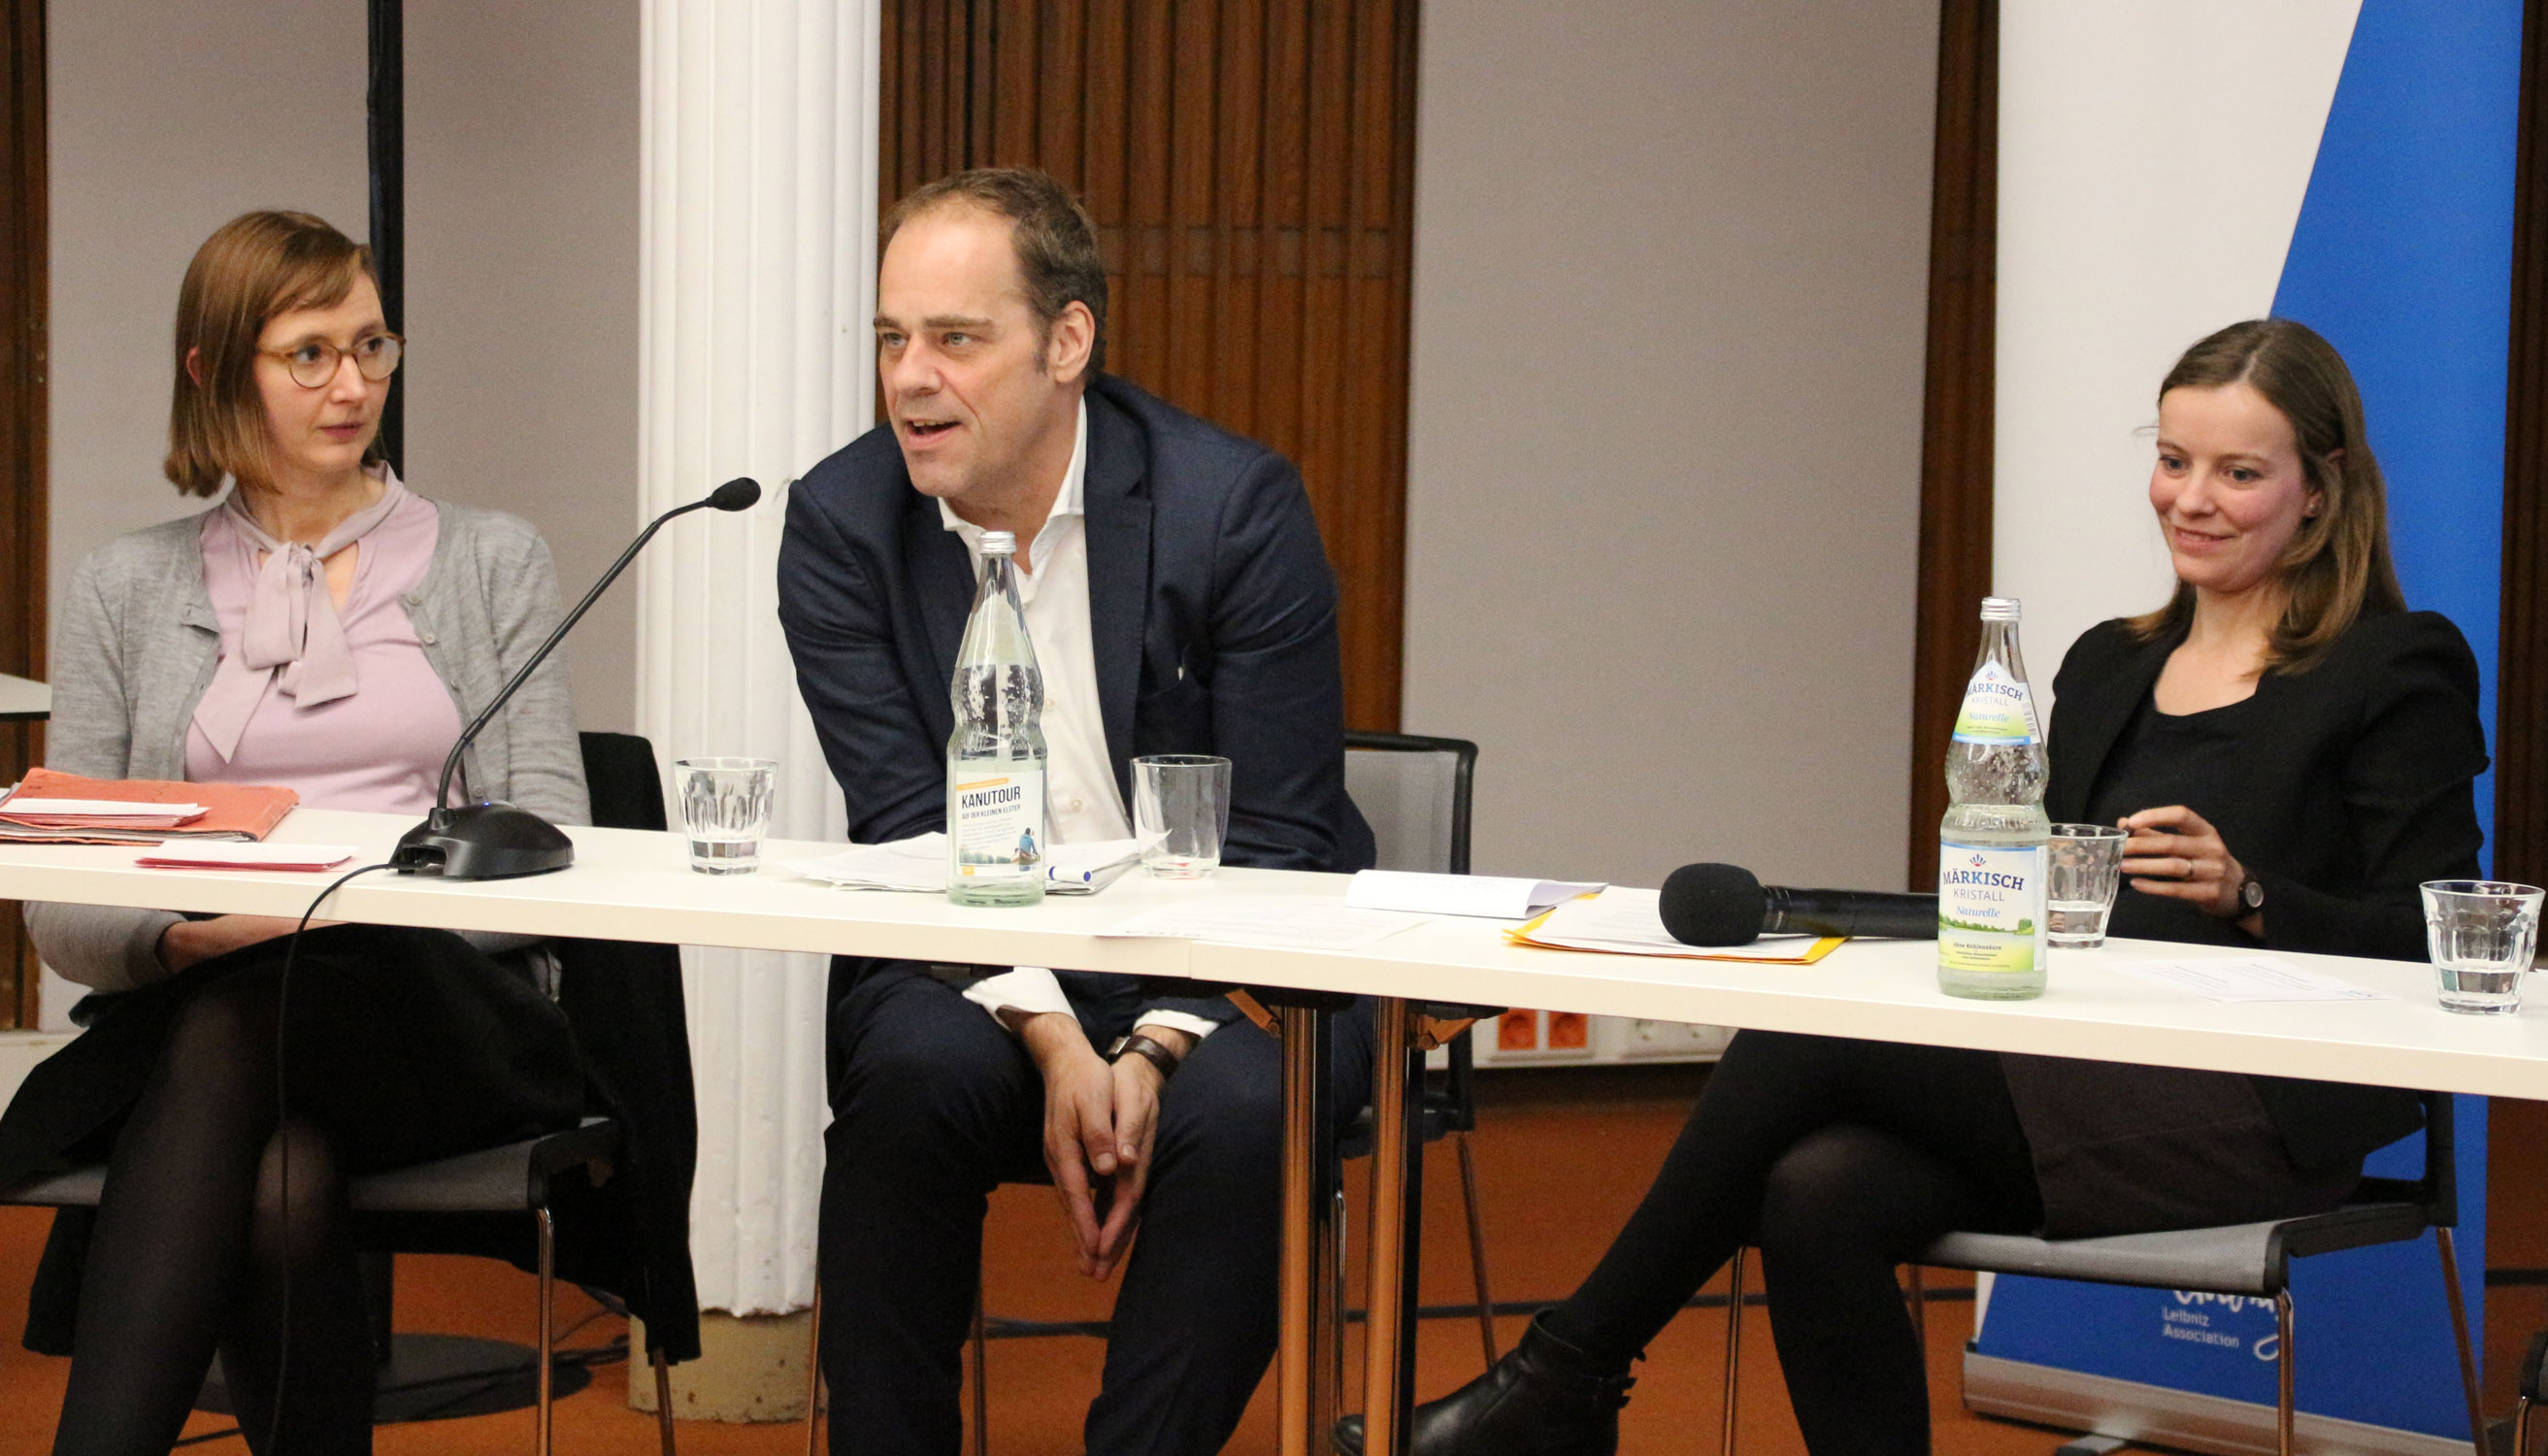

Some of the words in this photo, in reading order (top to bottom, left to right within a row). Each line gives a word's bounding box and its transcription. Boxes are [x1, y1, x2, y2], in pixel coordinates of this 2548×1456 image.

[1971, 696, 2008, 707] KRISTALL
[962, 786, 1021, 809] KANUTOUR
[980, 808, 1002, 817] KLEINEN
[1003, 804, 1021, 813] ELSTER
[1943, 868, 2025, 891] MÄRKISCH
[1953, 888, 2004, 902] KRISTALL
[1957, 906, 2001, 917] Naturelle
[2163, 1307, 2210, 1327] Leibniz
[2164, 1324, 2239, 1347] Association
